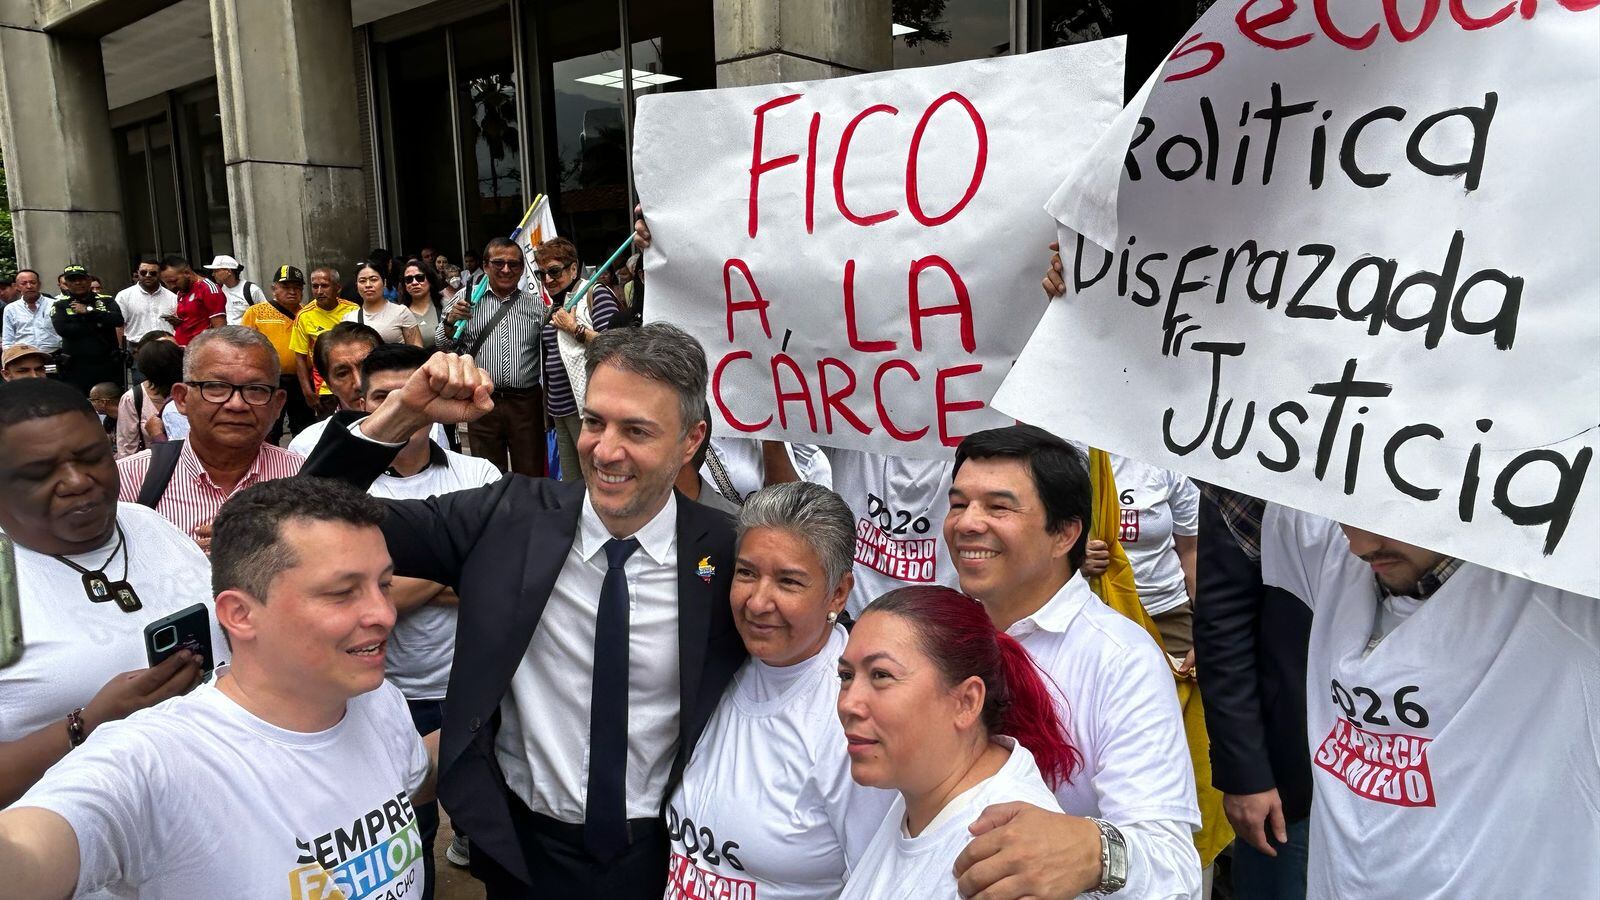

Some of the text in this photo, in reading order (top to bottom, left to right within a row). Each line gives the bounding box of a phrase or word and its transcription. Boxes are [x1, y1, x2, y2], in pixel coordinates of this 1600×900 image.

[748, 91, 988, 239] FICO
[723, 254, 977, 354] A LA
[712, 329, 985, 448] CÁRCE
[1163, 341, 1593, 557] Justicia
